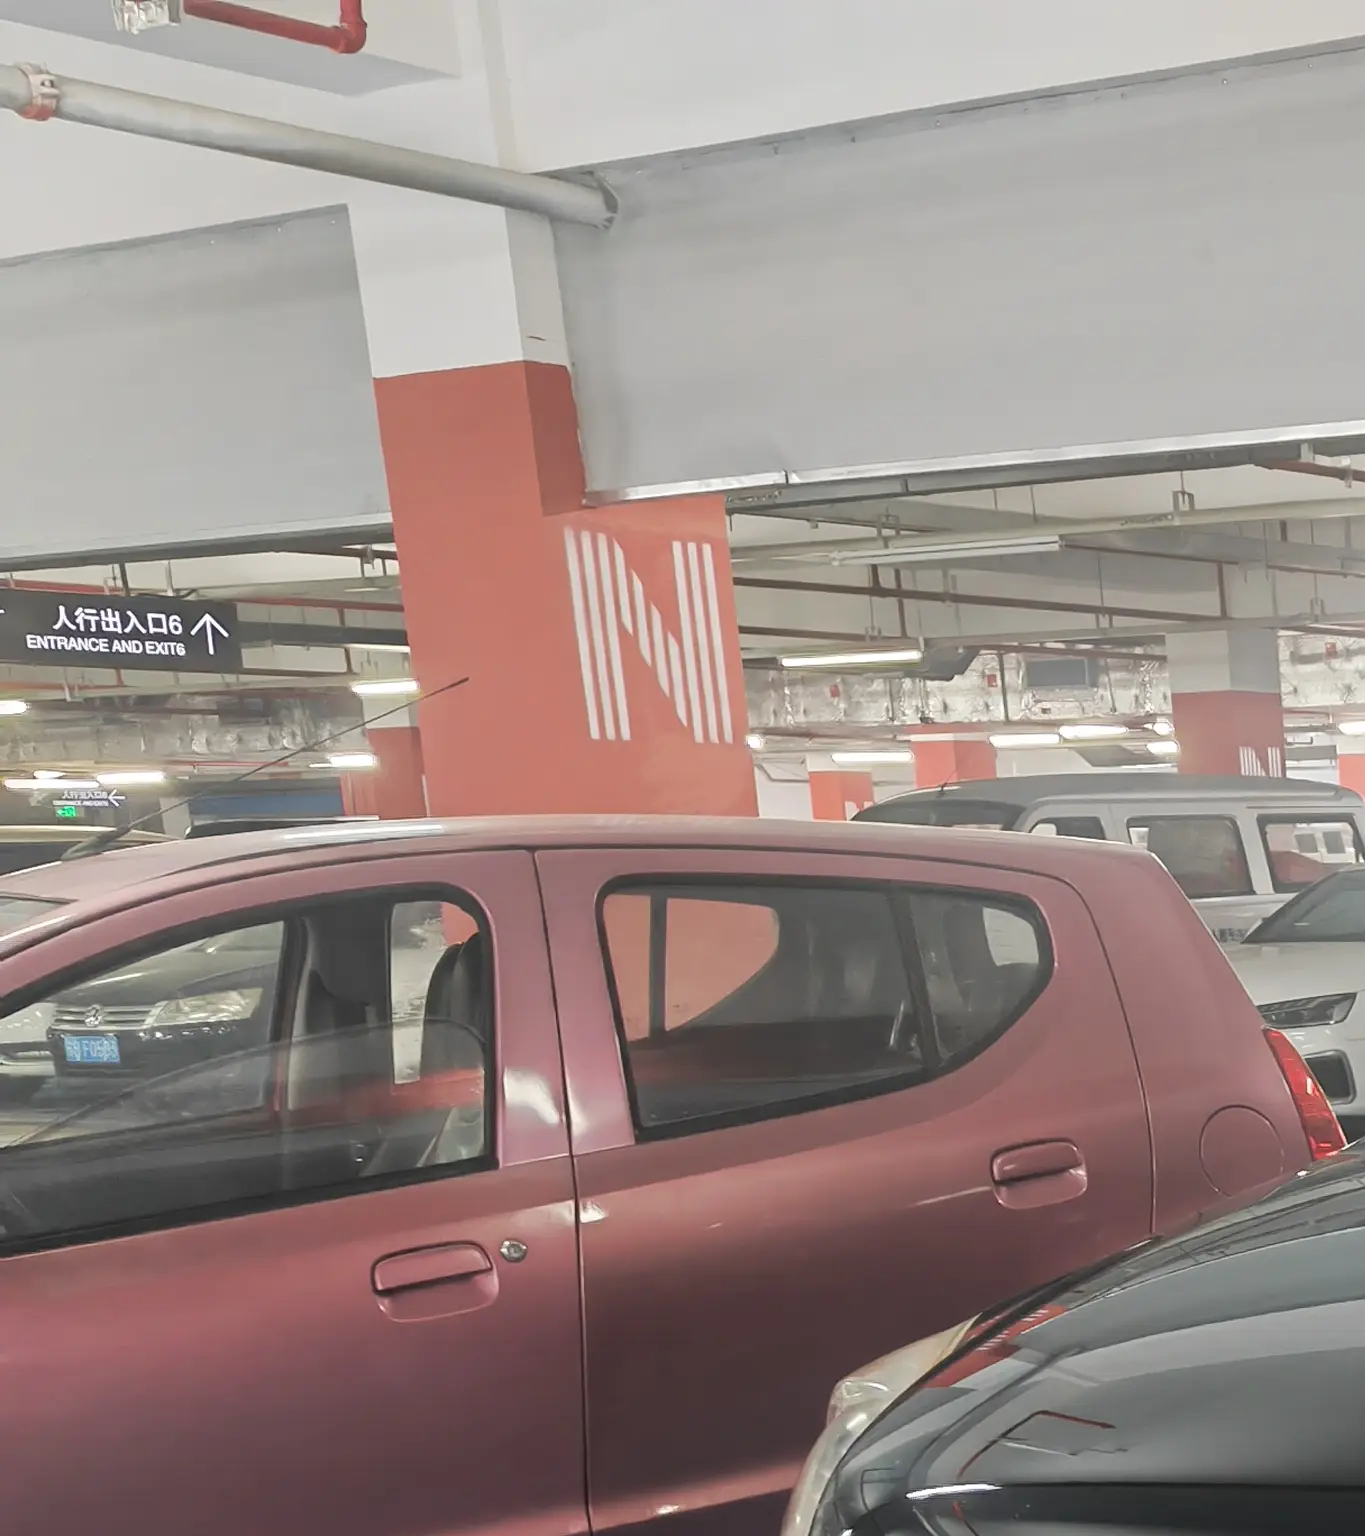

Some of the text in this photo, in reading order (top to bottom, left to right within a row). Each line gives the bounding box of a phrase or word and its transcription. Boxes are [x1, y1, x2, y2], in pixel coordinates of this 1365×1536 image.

[52, 604, 183, 636] 人行出入口6
[564, 526, 733, 744] N
[26, 634, 186, 657] ENTRANCE AND EXIT6
